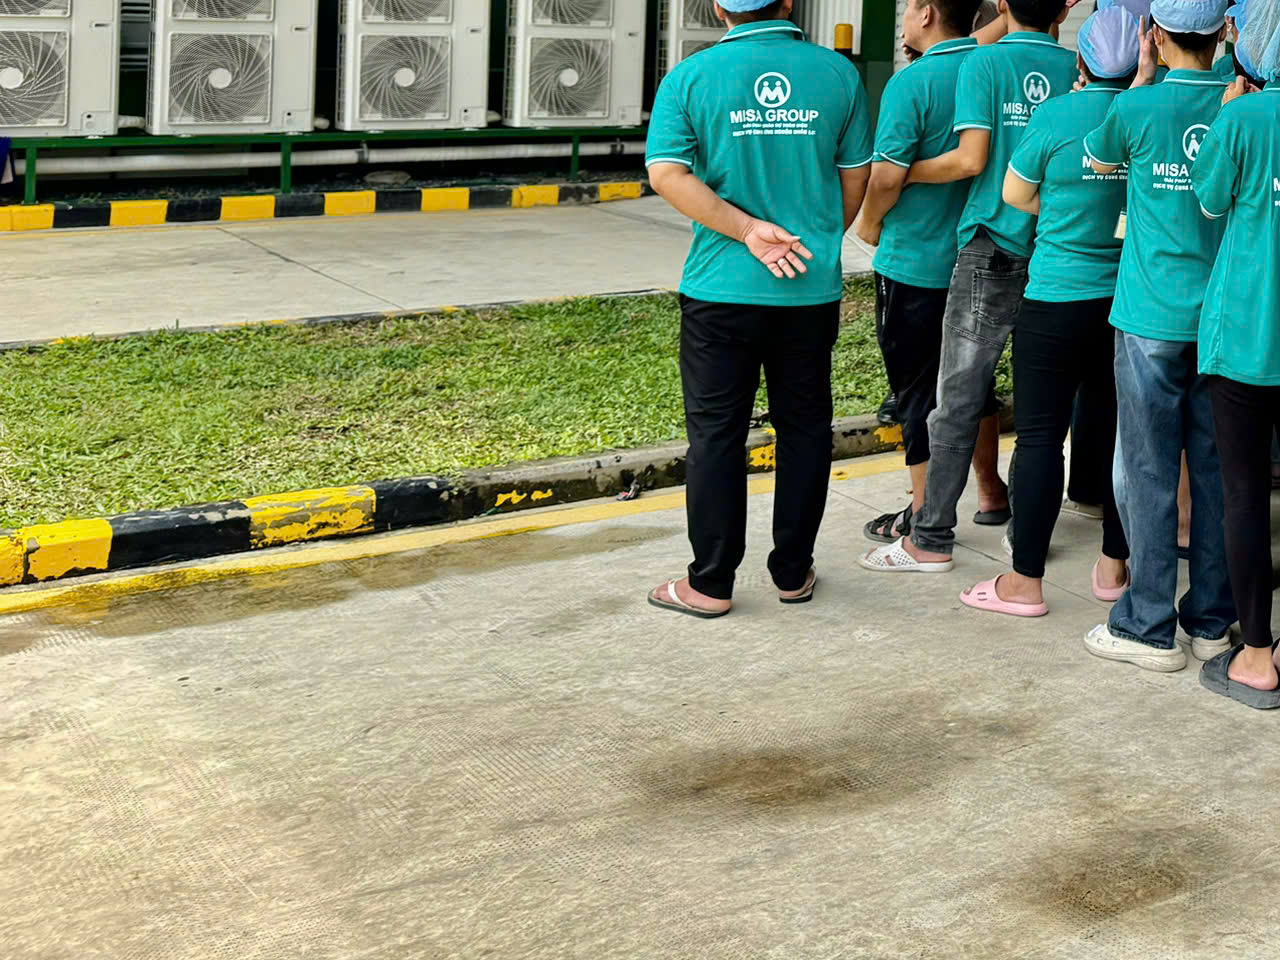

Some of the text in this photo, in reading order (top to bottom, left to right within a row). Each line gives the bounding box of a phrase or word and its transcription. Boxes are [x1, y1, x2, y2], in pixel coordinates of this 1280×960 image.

[1003, 102, 1029, 115] MISA
[730, 109, 819, 123] MISA GROUP
[1153, 163, 1189, 177] MISA
